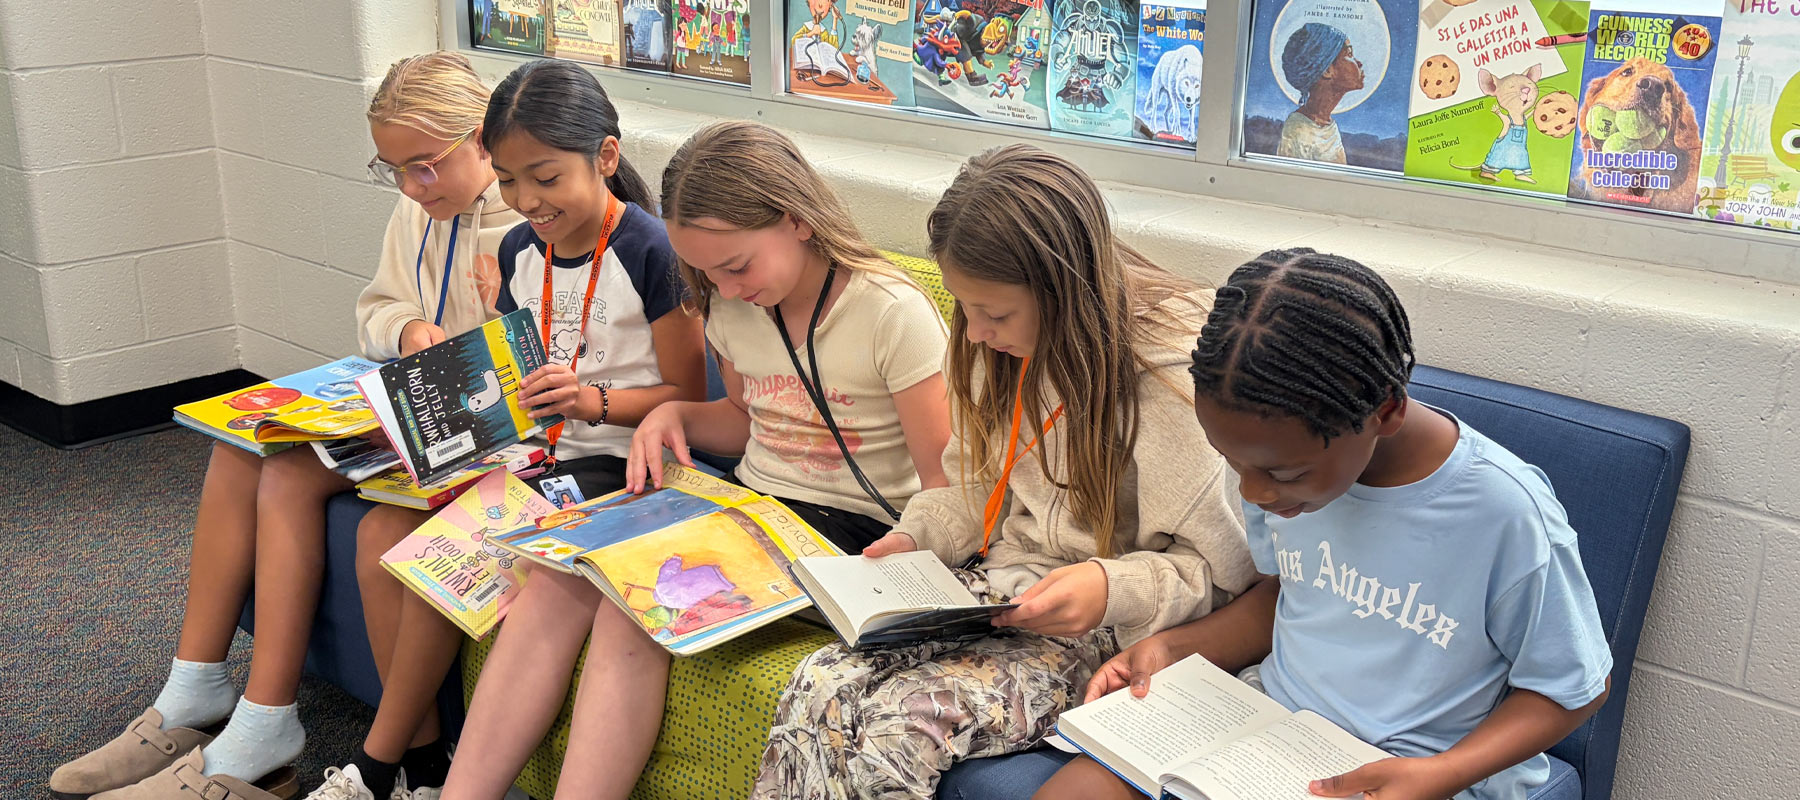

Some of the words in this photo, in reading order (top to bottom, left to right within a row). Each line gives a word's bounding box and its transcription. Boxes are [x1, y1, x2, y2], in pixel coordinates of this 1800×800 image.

[855, 2, 877, 13] Answers
[877, 7, 887, 15] the
[887, 9, 899, 18] Call
[1143, 24, 1155, 33] The
[1156, 25, 1188, 40] White
[1188, 28, 1204, 41] Wo
[1437, 27, 1451, 42] SI
[1453, 21, 1467, 39] LE
[1469, 13, 1492, 32] DAS
[1494, 4, 1519, 24] UNA
[1597, 14, 1674, 34] GUINNESS
[1682, 27, 1707, 40] TOP
[1456, 25, 1516, 54] GALLETITA
[1521, 21, 1528, 36] A
[1473, 50, 1490, 67] UN
[1493, 36, 1531, 61] RATÓN
[1593, 43, 1668, 64] RECORDS
[1678, 41, 1701, 57] 40
[1412, 118, 1433, 129] Laura
[1434, 111, 1450, 123] Joffe
[1450, 101, 1485, 118] Numeroff
[1419, 142, 1441, 155] Felicia
[1441, 136, 1460, 149] Bond
[1587, 149, 1677, 170] Incredible
[1592, 170, 1670, 190] Collection
[1725, 202, 1755, 214] JORY
[1756, 205, 1787, 218] JOHN
[1770, 198, 1785, 206] New
[519, 335, 537, 374] LANTON
[405, 366, 442, 450] RWHALICORN
[425, 383, 447, 419] JELLY
[441, 423, 452, 439] AND
[509, 485, 547, 515] CLANTON
[429, 534, 466, 562] TOOTH
[414, 546, 477, 597] RWHAL'S
[1312, 540, 1460, 650] Angeles
